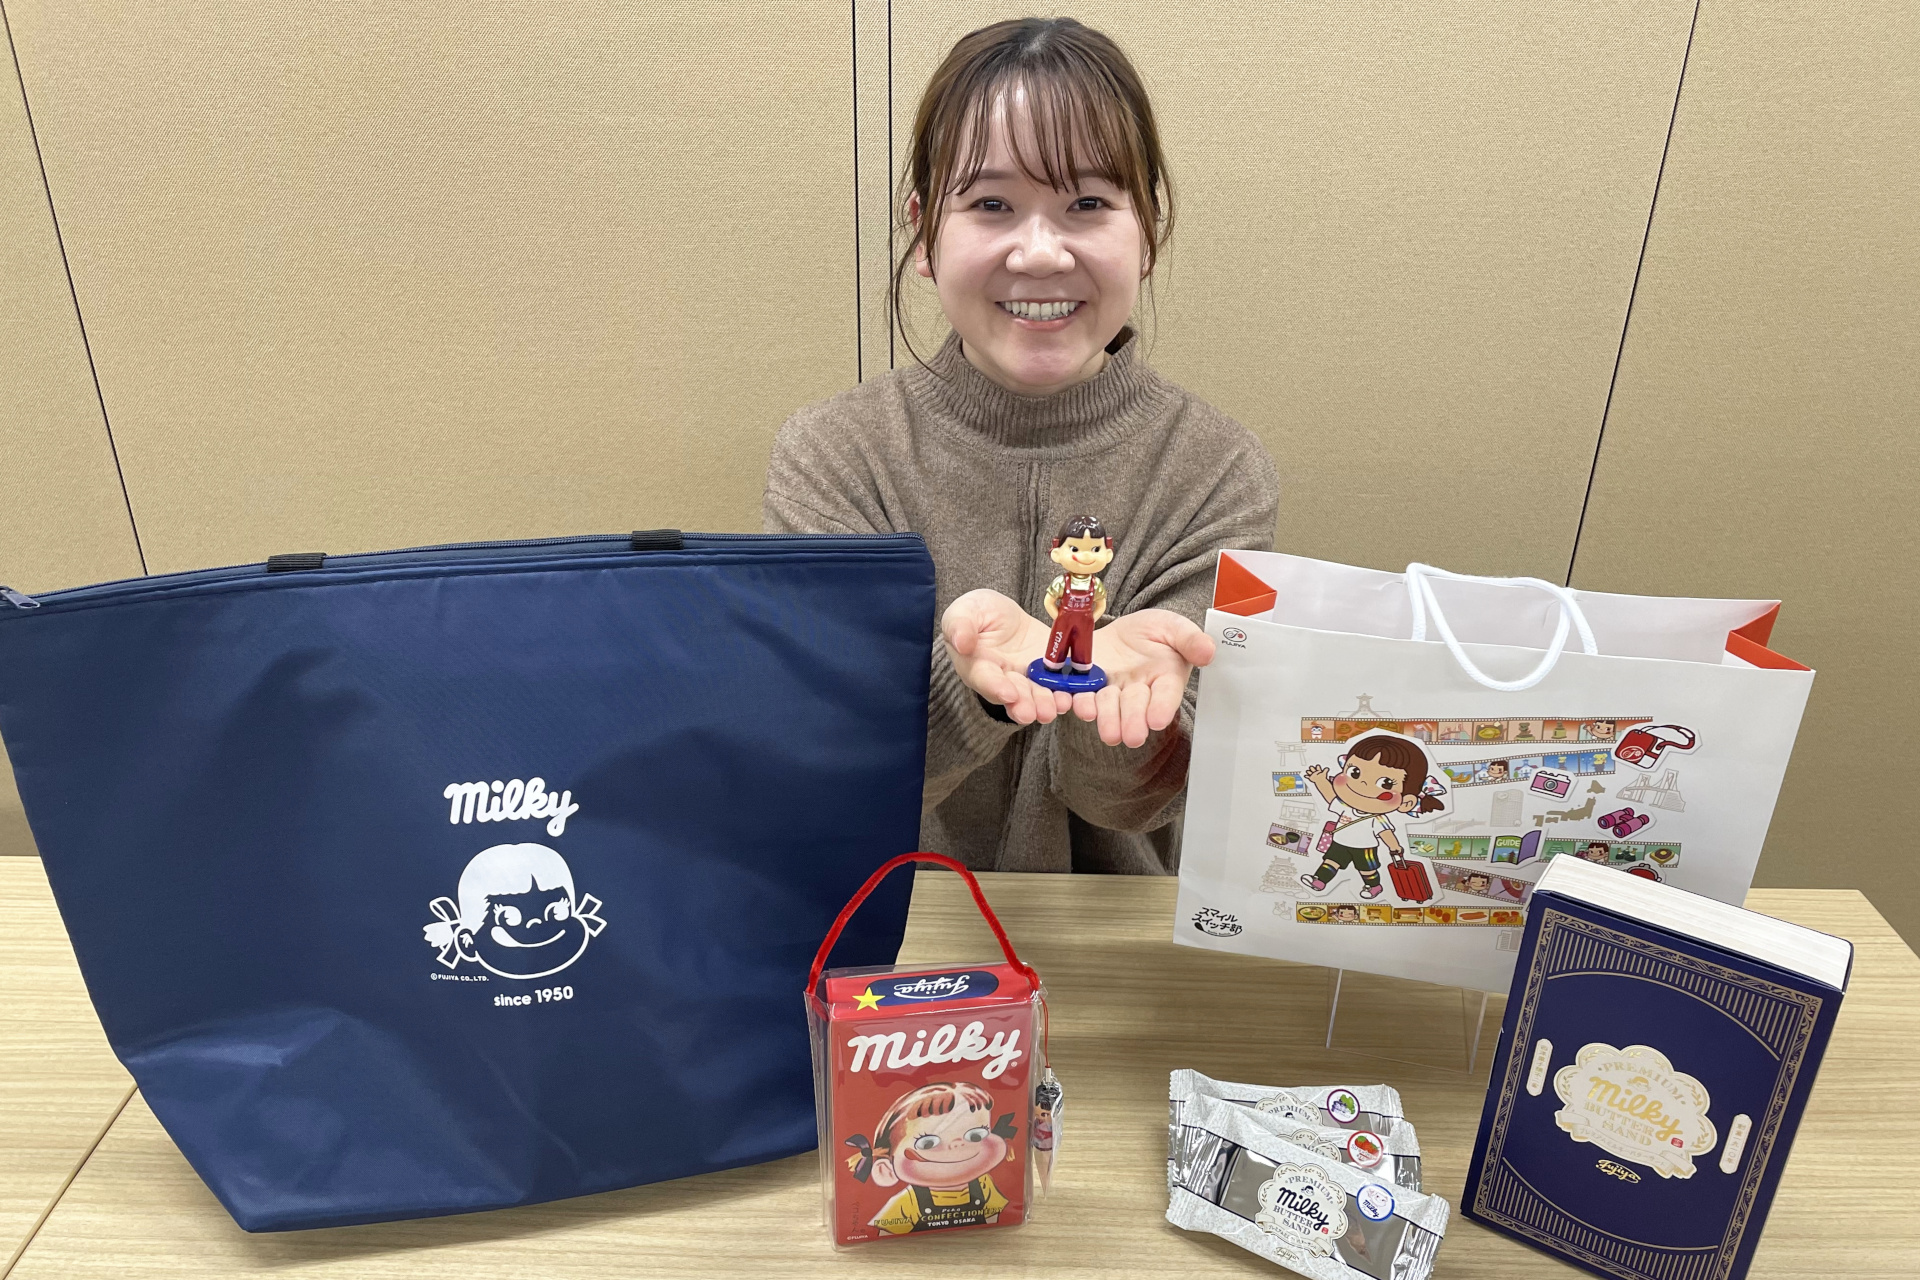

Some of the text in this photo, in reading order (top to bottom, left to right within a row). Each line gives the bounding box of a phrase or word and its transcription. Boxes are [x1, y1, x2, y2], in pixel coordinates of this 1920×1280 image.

[1221, 640, 1246, 649] FUJIYA
[1496, 839, 1520, 847] GUIDE
[1191, 914, 1242, 933] スイッチ部
[1199, 907, 1238, 922] スマイル
[494, 986, 574, 1006] since 1950
[1602, 1062, 1685, 1100] PREMIUM
[1583, 1101, 1655, 1137] BUTTER
[1602, 1120, 1652, 1146] SAND
[1288, 1175, 1333, 1201] PREMIUM
[873, 1218, 912, 1227] FUJIYA
[954, 1217, 976, 1225] OSAKA
[1273, 1205, 1313, 1228] BUTTER
[1282, 1218, 1311, 1235] SAND
